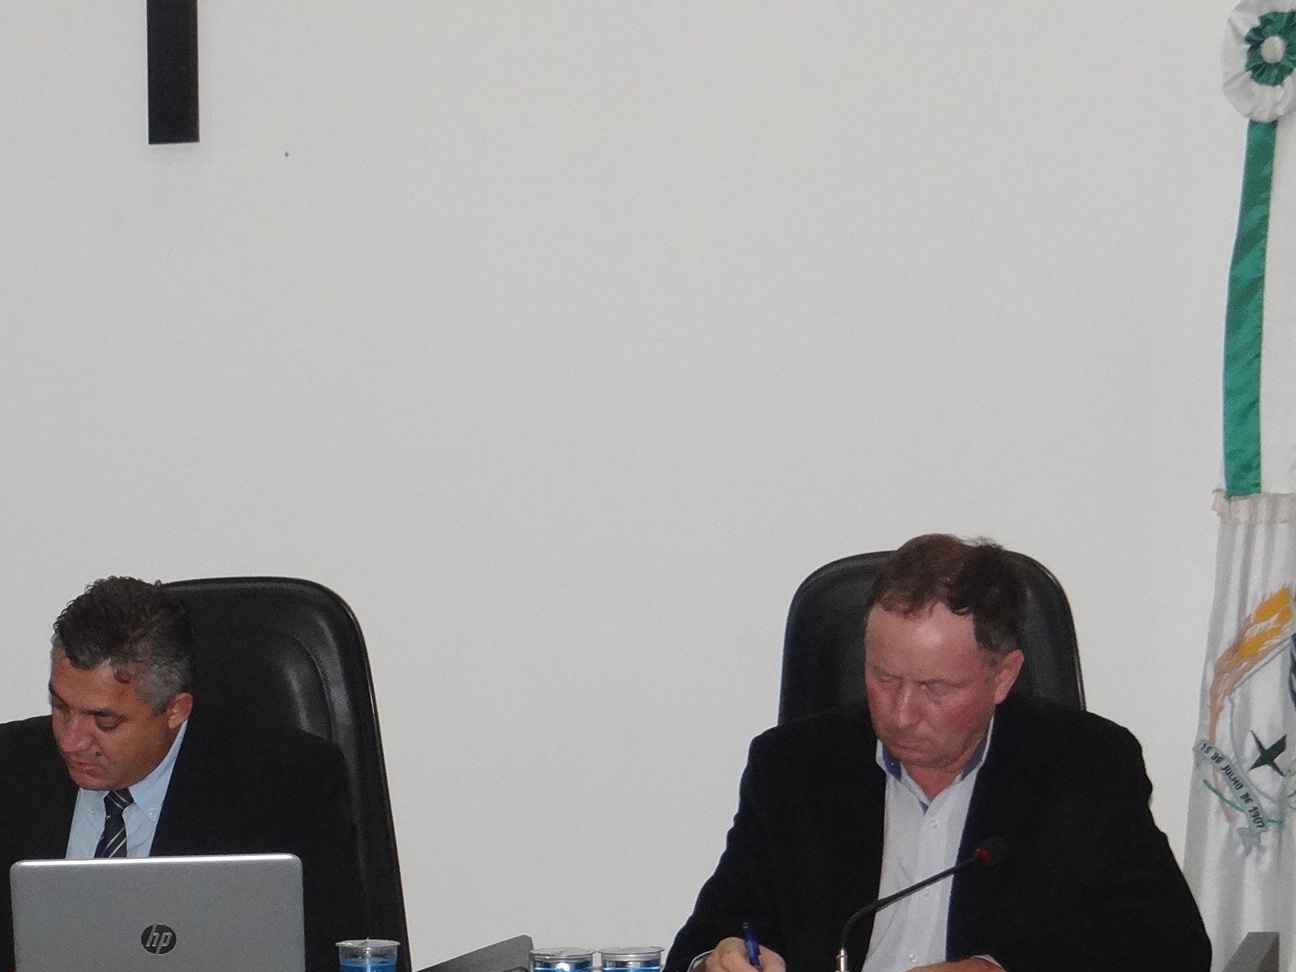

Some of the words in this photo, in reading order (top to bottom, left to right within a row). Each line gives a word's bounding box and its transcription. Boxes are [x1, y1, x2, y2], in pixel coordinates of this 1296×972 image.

[1199, 742, 1213, 754] 15
[1210, 752, 1225, 764] DE
[1219, 764, 1244, 790] JULHO
[1239, 791, 1254, 805] DE
[1248, 806, 1266, 829] 1907
[145, 924, 173, 954] hp
